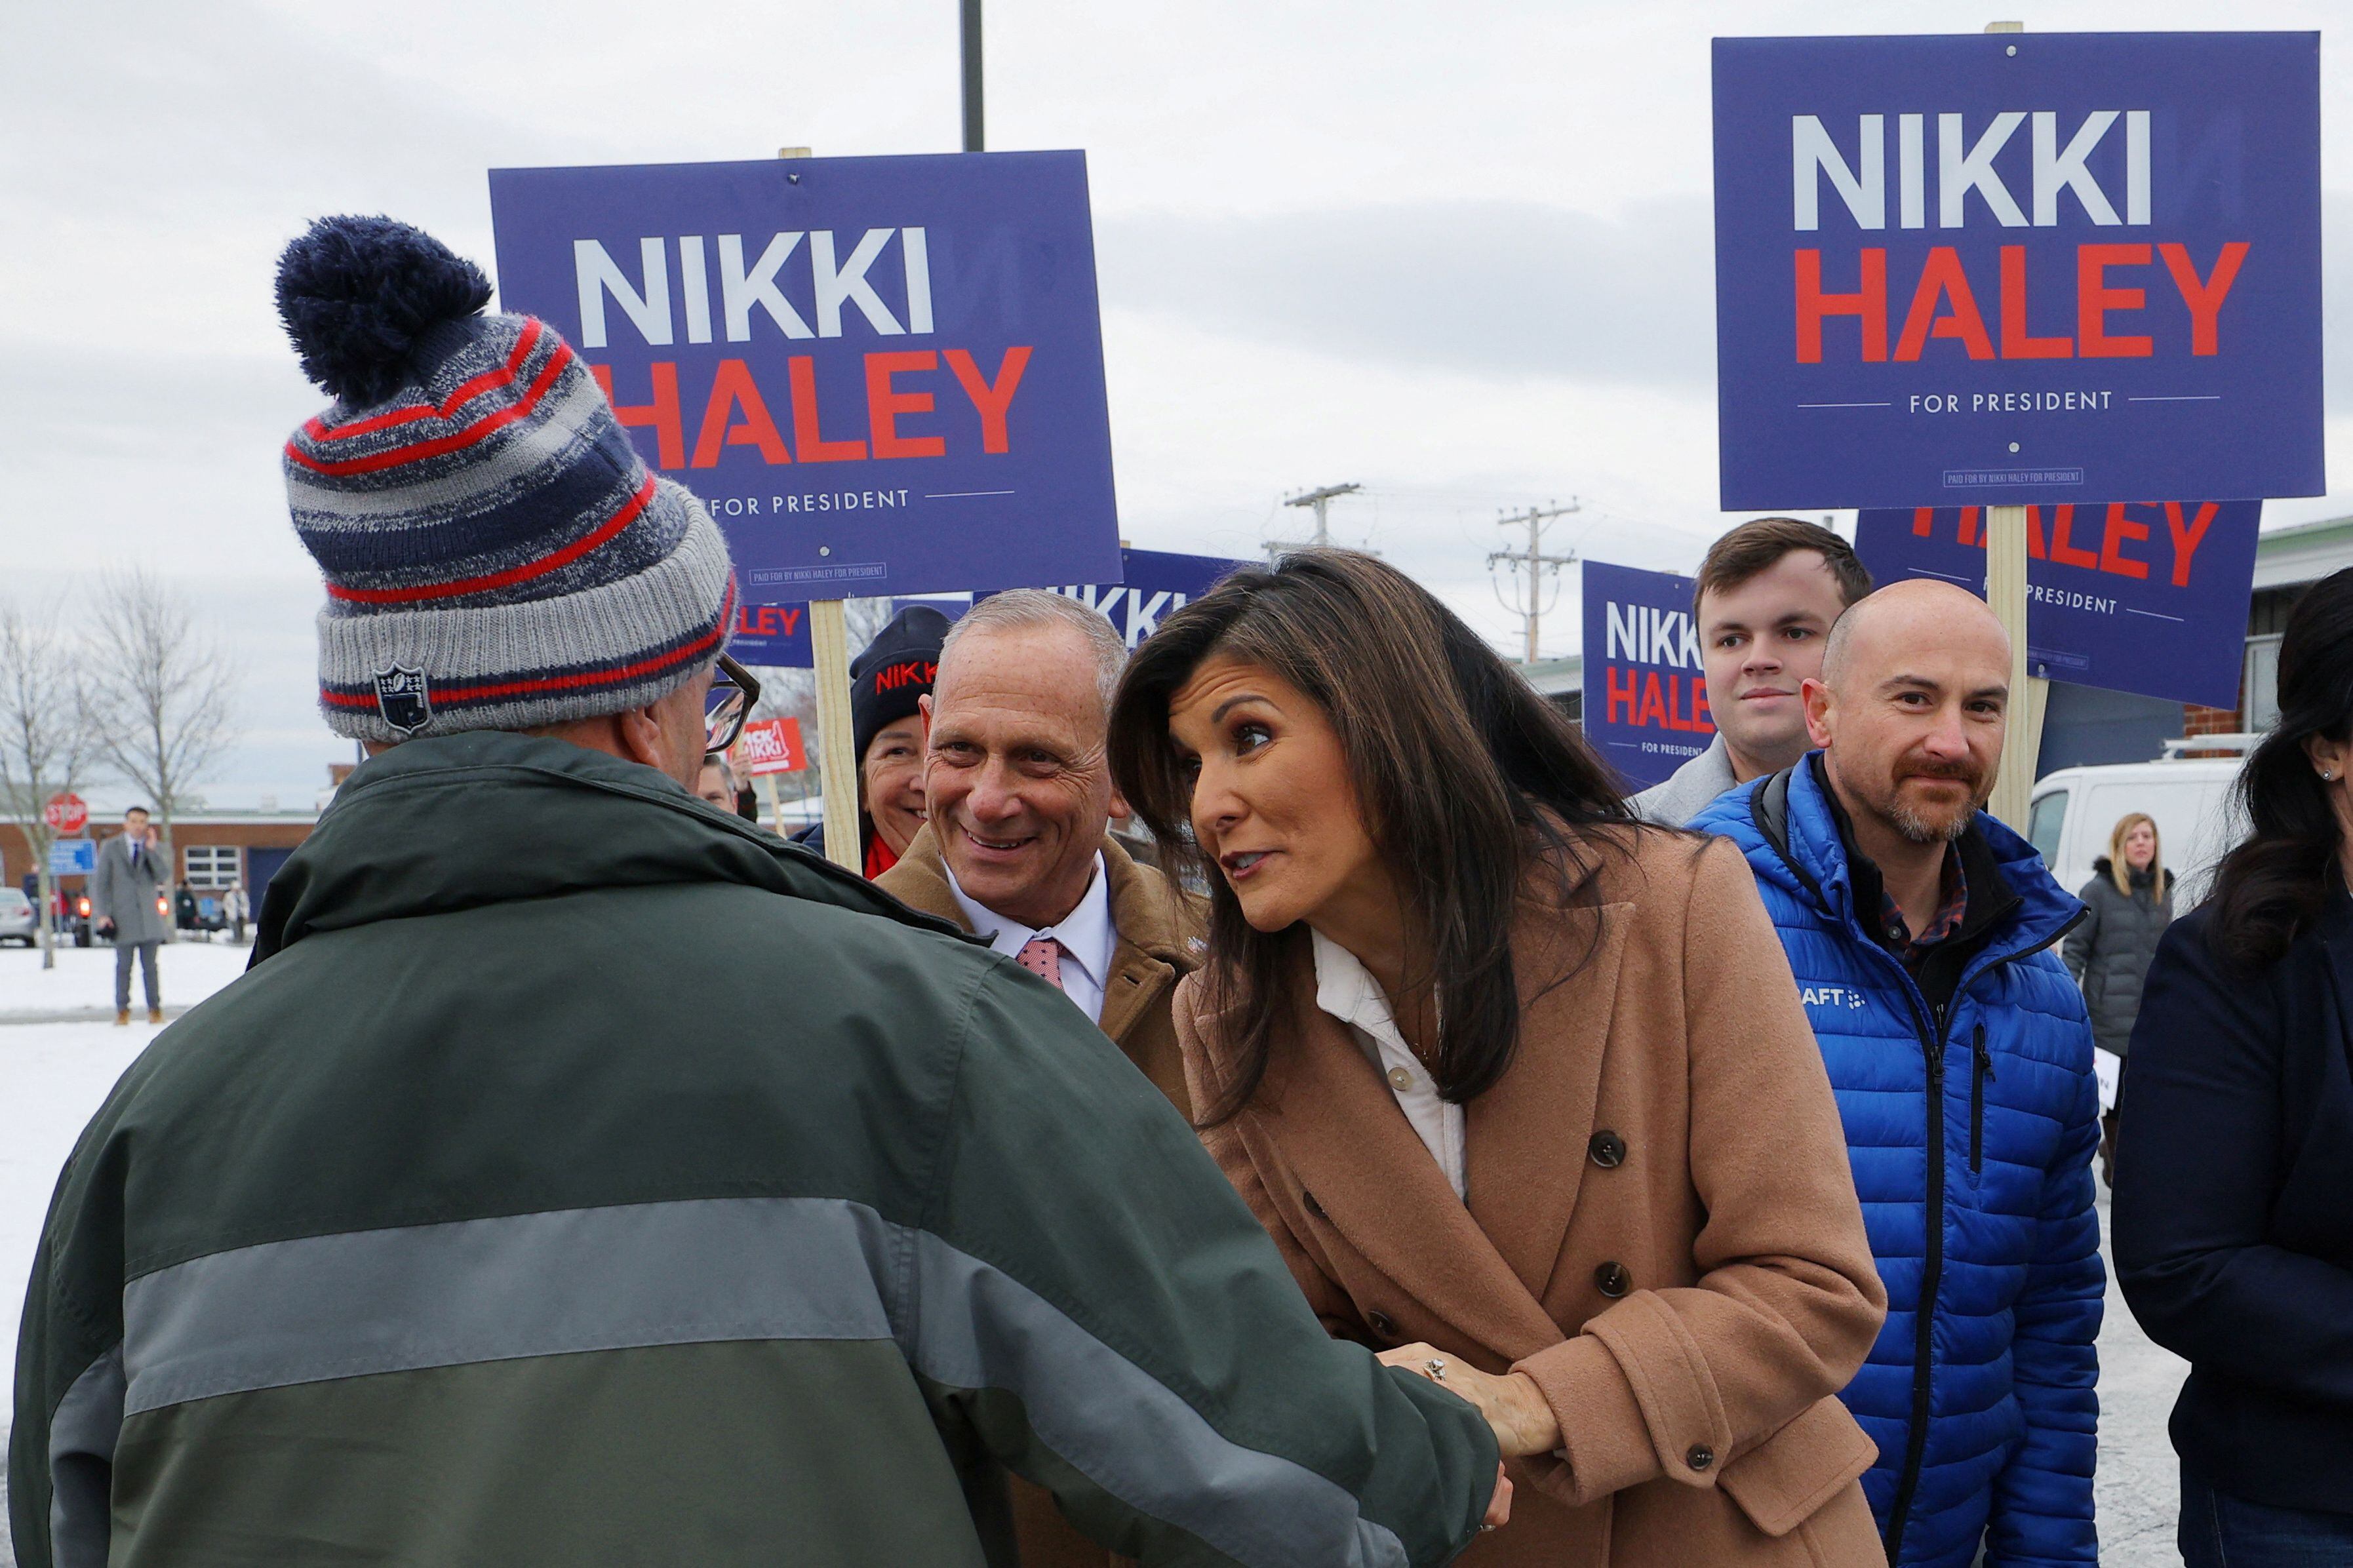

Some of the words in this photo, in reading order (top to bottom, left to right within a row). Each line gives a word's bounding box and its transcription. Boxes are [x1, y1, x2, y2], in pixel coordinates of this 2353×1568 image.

[1792, 109, 2151, 231] NIKKI
[573, 226, 935, 349] NIKKI
[1795, 242, 2250, 364] HALEY
[591, 346, 1033, 469] HALEY
[1909, 393, 1960, 414] FOR
[1972, 391, 2113, 412] PRESIDENT
[1948, 475, 1963, 484] PAID
[1965, 474, 1977, 484] FOR
[1979, 474, 1987, 483] BY
[1988, 473, 2006, 483] NIKKI
[2008, 473, 2028, 482] HALEY
[2030, 473, 2043, 482] FOR
[2044, 471, 2079, 482] PRESIDENT
[711, 497, 760, 517] FOR
[772, 489, 909, 514] PRESIDENT
[754, 572, 769, 582] PAID
[770, 572, 783, 581] FOR
[784, 572, 793, 581] BY
[794, 570, 811, 580] NIKKI
[814, 569, 833, 579] HALEY
[835, 568, 847, 578] FOR
[848, 566, 882, 577] PRESIDENT
[2027, 583, 2117, 615] PRESIDENT
[1642, 742, 1658, 753] FOR
[47, 802, 85, 821] STOP
[1798, 987, 1844, 1006] AFT
